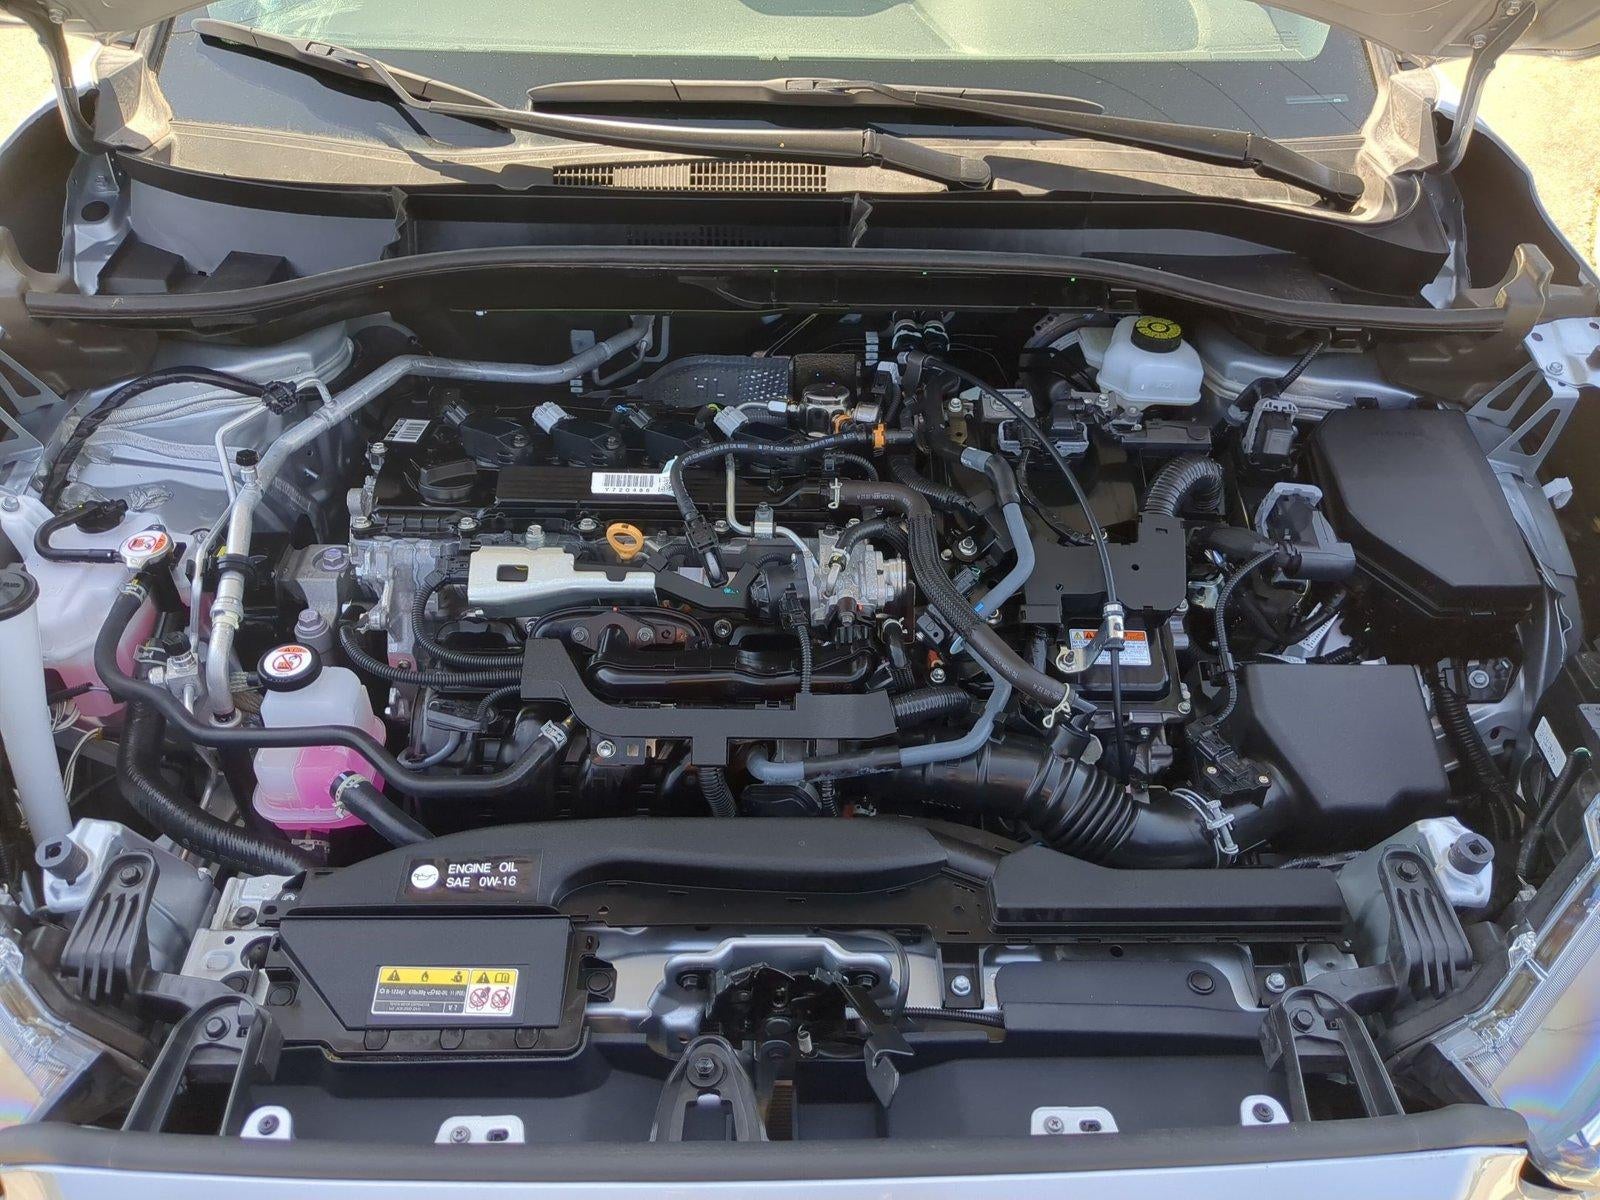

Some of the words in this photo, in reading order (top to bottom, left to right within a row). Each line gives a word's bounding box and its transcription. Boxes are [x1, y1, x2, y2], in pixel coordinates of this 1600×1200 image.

[448, 862, 492, 875] ENGINE
[498, 861, 518, 873] OIL
[445, 877, 471, 888] SAE
[478, 875, 517, 887] 0W-16
